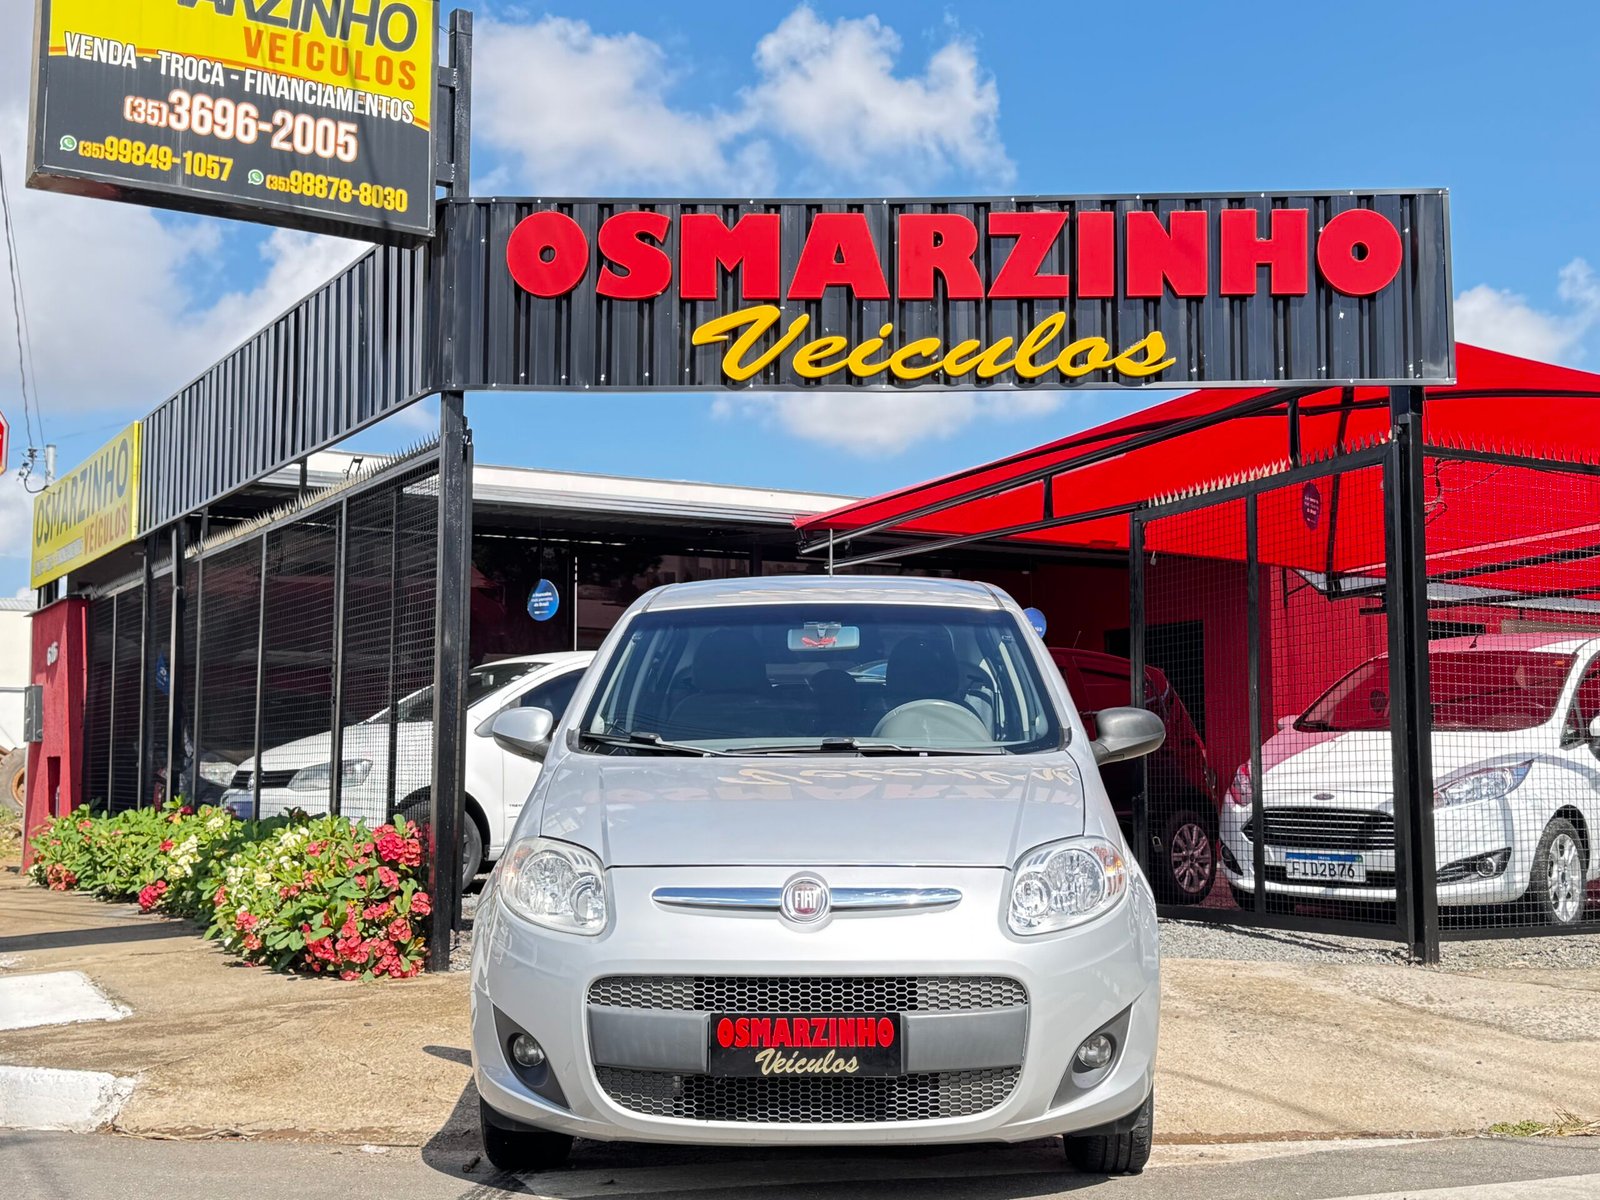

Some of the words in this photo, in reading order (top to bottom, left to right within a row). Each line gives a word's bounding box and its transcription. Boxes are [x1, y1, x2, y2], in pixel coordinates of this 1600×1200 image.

[65, 31, 137, 69] VENDA
[157, 50, 225, 87] TROCA
[244, 68, 416, 124] FINANCIAMENTOS
[243, 26, 416, 90] VEÍCULOS
[506, 208, 1404, 301] OSMARZINHO
[36, 438, 129, 547] OSMARZINHO
[794, 890, 820, 909] FIAT
[1292, 861, 1355, 879] FID2B76
[716, 1017, 895, 1048] OSMARZINHO
